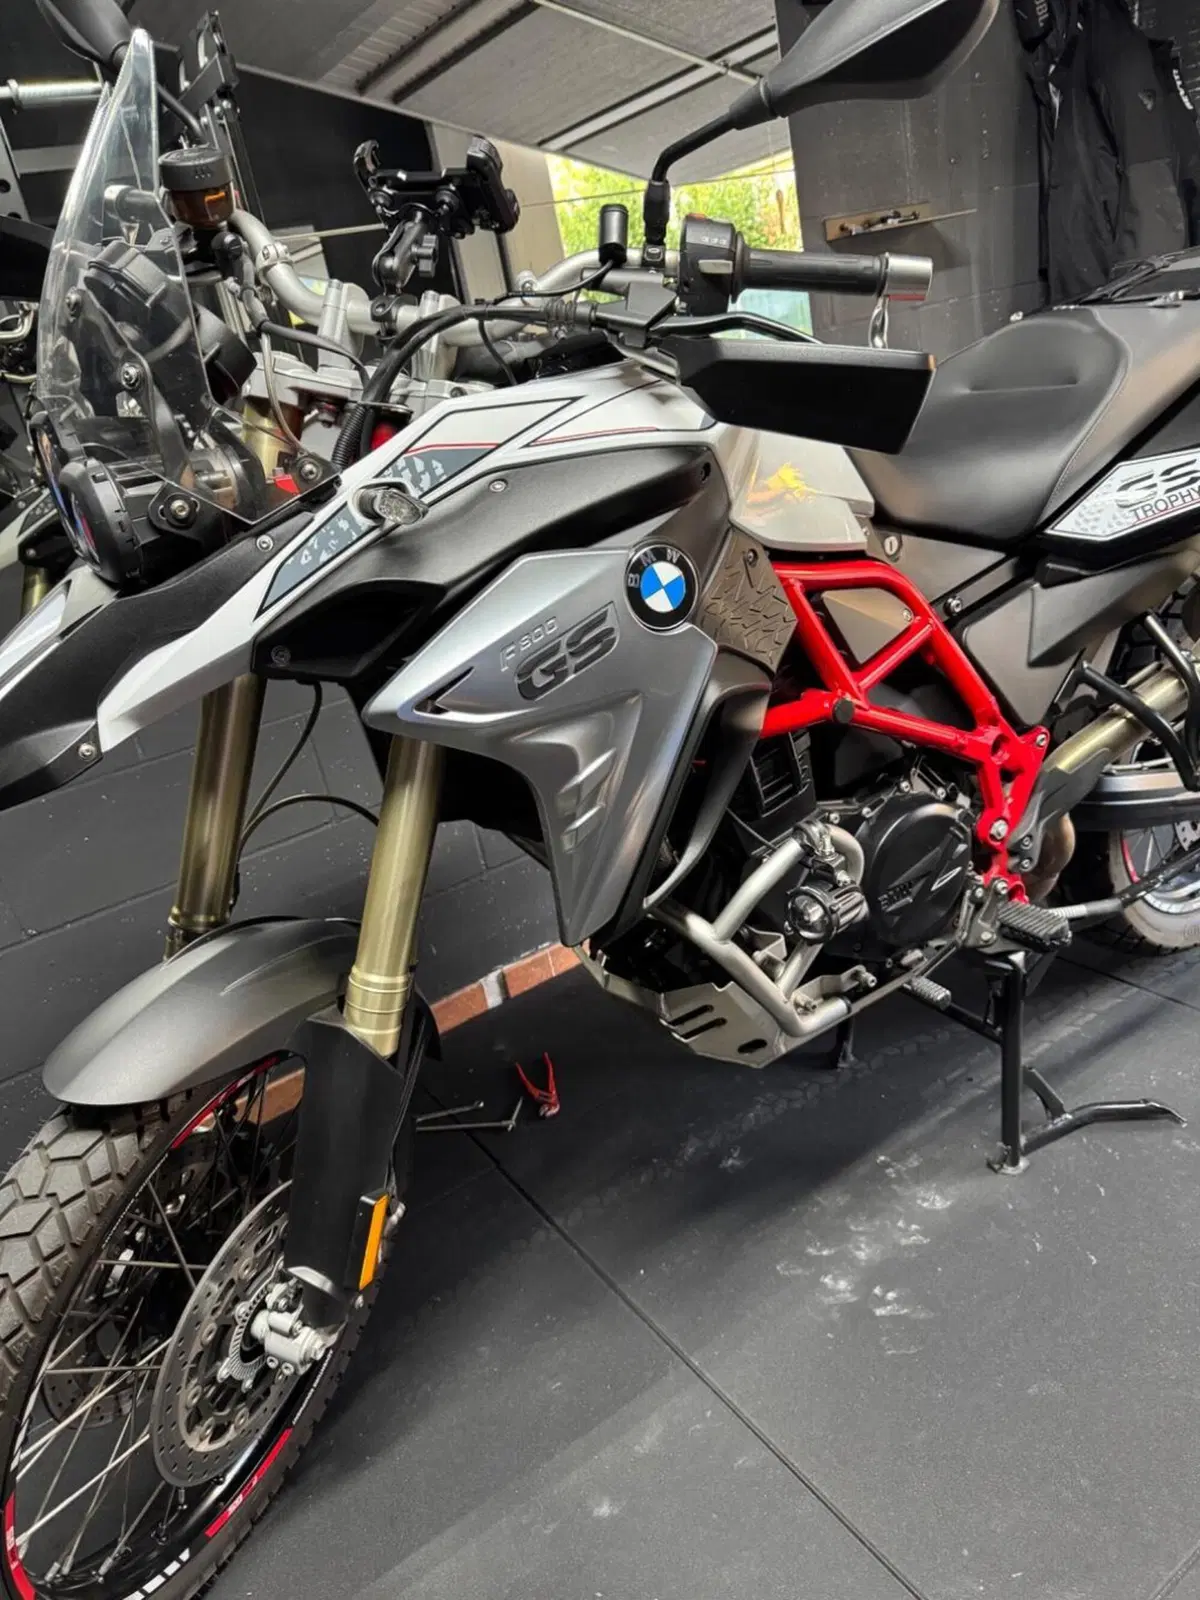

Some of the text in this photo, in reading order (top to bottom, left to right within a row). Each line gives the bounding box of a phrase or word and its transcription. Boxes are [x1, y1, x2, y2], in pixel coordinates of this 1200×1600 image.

[1131, 486, 1200, 521] TROPHY
[628, 549, 680, 588] BMW
[500, 642, 517, 672] F
[514, 601, 619, 701] GS
